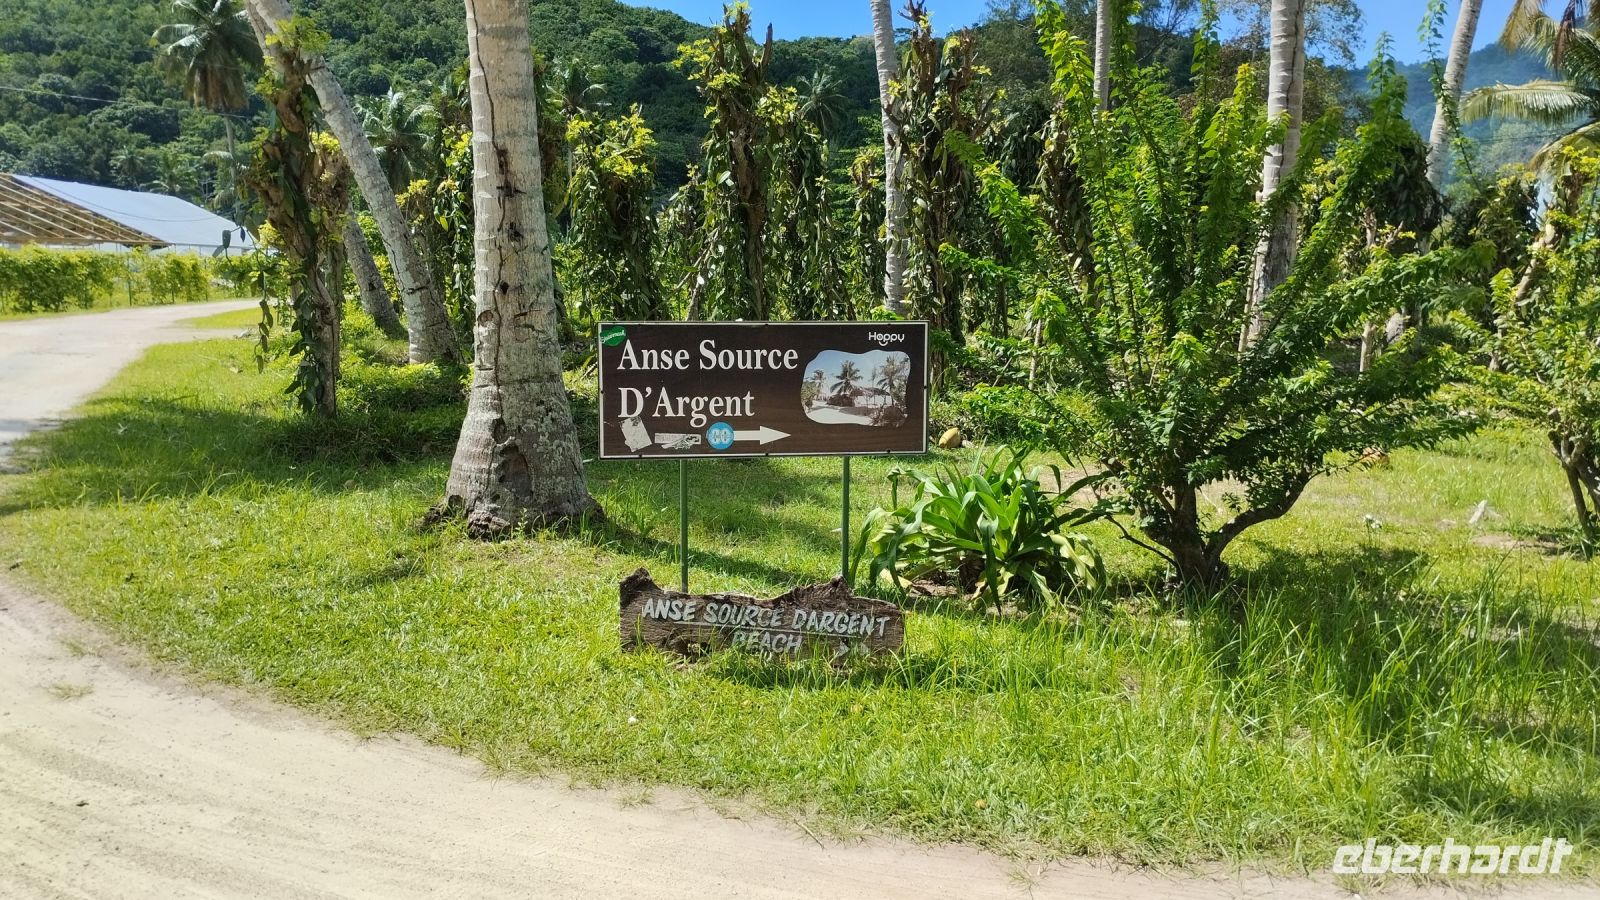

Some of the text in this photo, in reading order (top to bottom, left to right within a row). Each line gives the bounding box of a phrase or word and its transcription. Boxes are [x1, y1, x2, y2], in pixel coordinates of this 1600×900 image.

[617, 339, 798, 369] Anse Source
[641, 598, 891, 636] ANSE SOURCE DARGENT
[730, 631, 803, 657] BEACH
